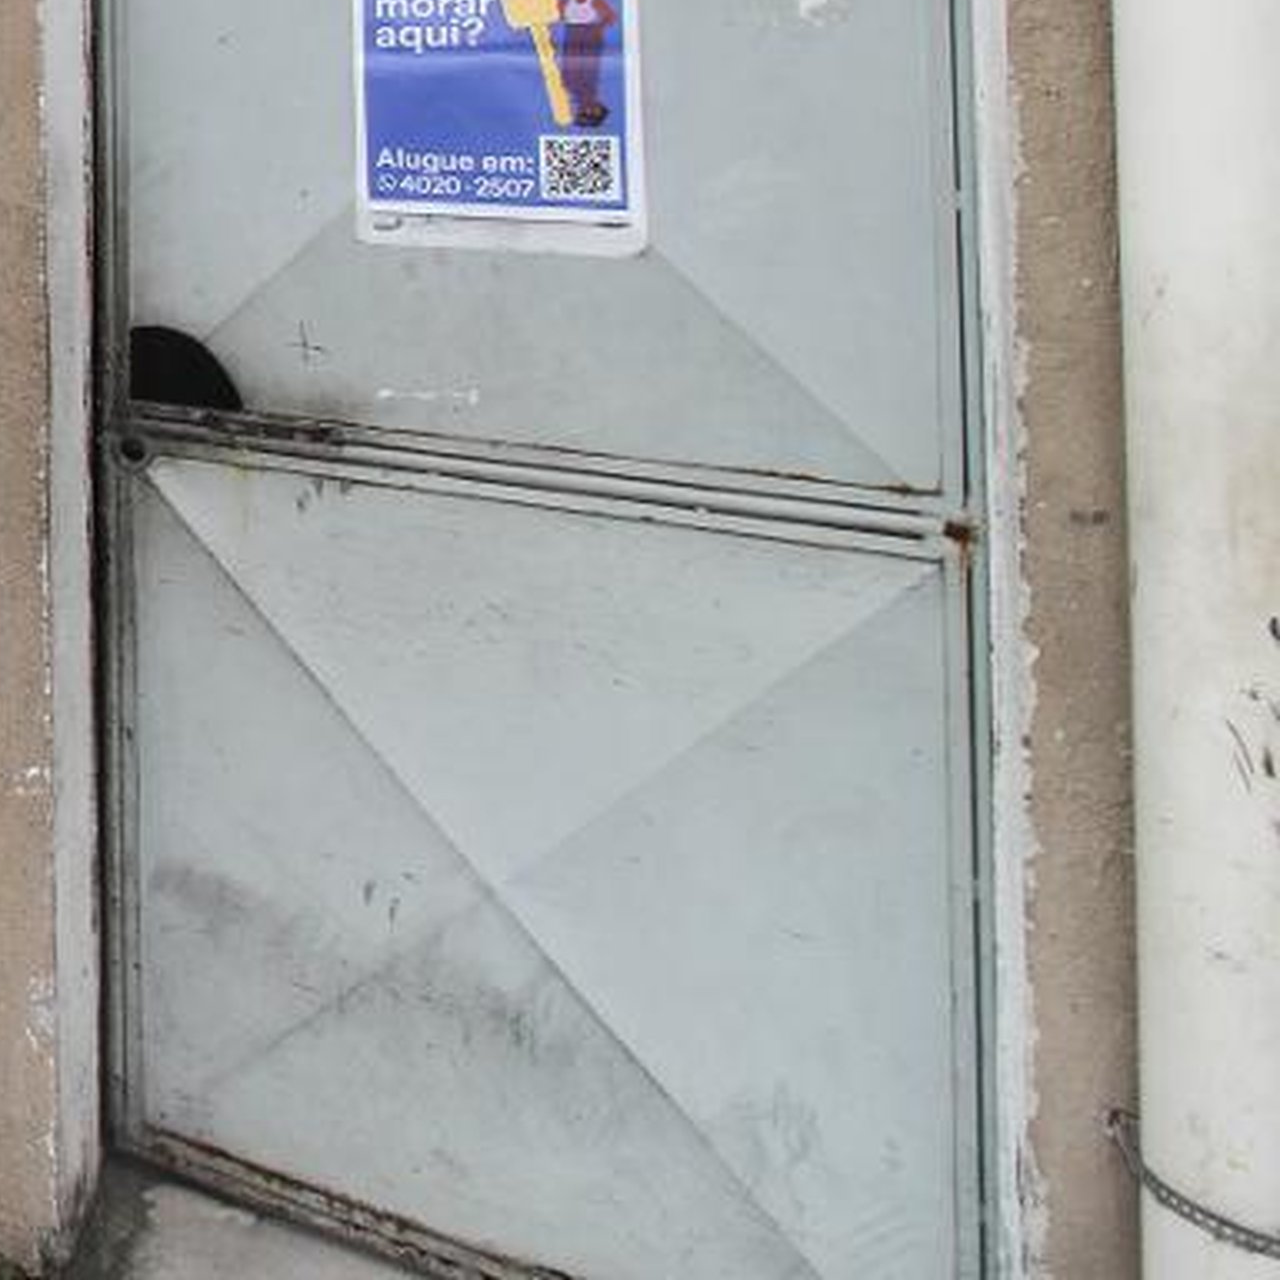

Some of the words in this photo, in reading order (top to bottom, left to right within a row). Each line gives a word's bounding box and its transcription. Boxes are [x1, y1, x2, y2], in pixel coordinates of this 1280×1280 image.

[375, 17, 485, 52] aqui?
[376, 148, 474, 176] Alugue
[481, 151, 534, 173] em:
[399, 173, 460, 195] 4020
[474, 177, 535, 197] 2507
